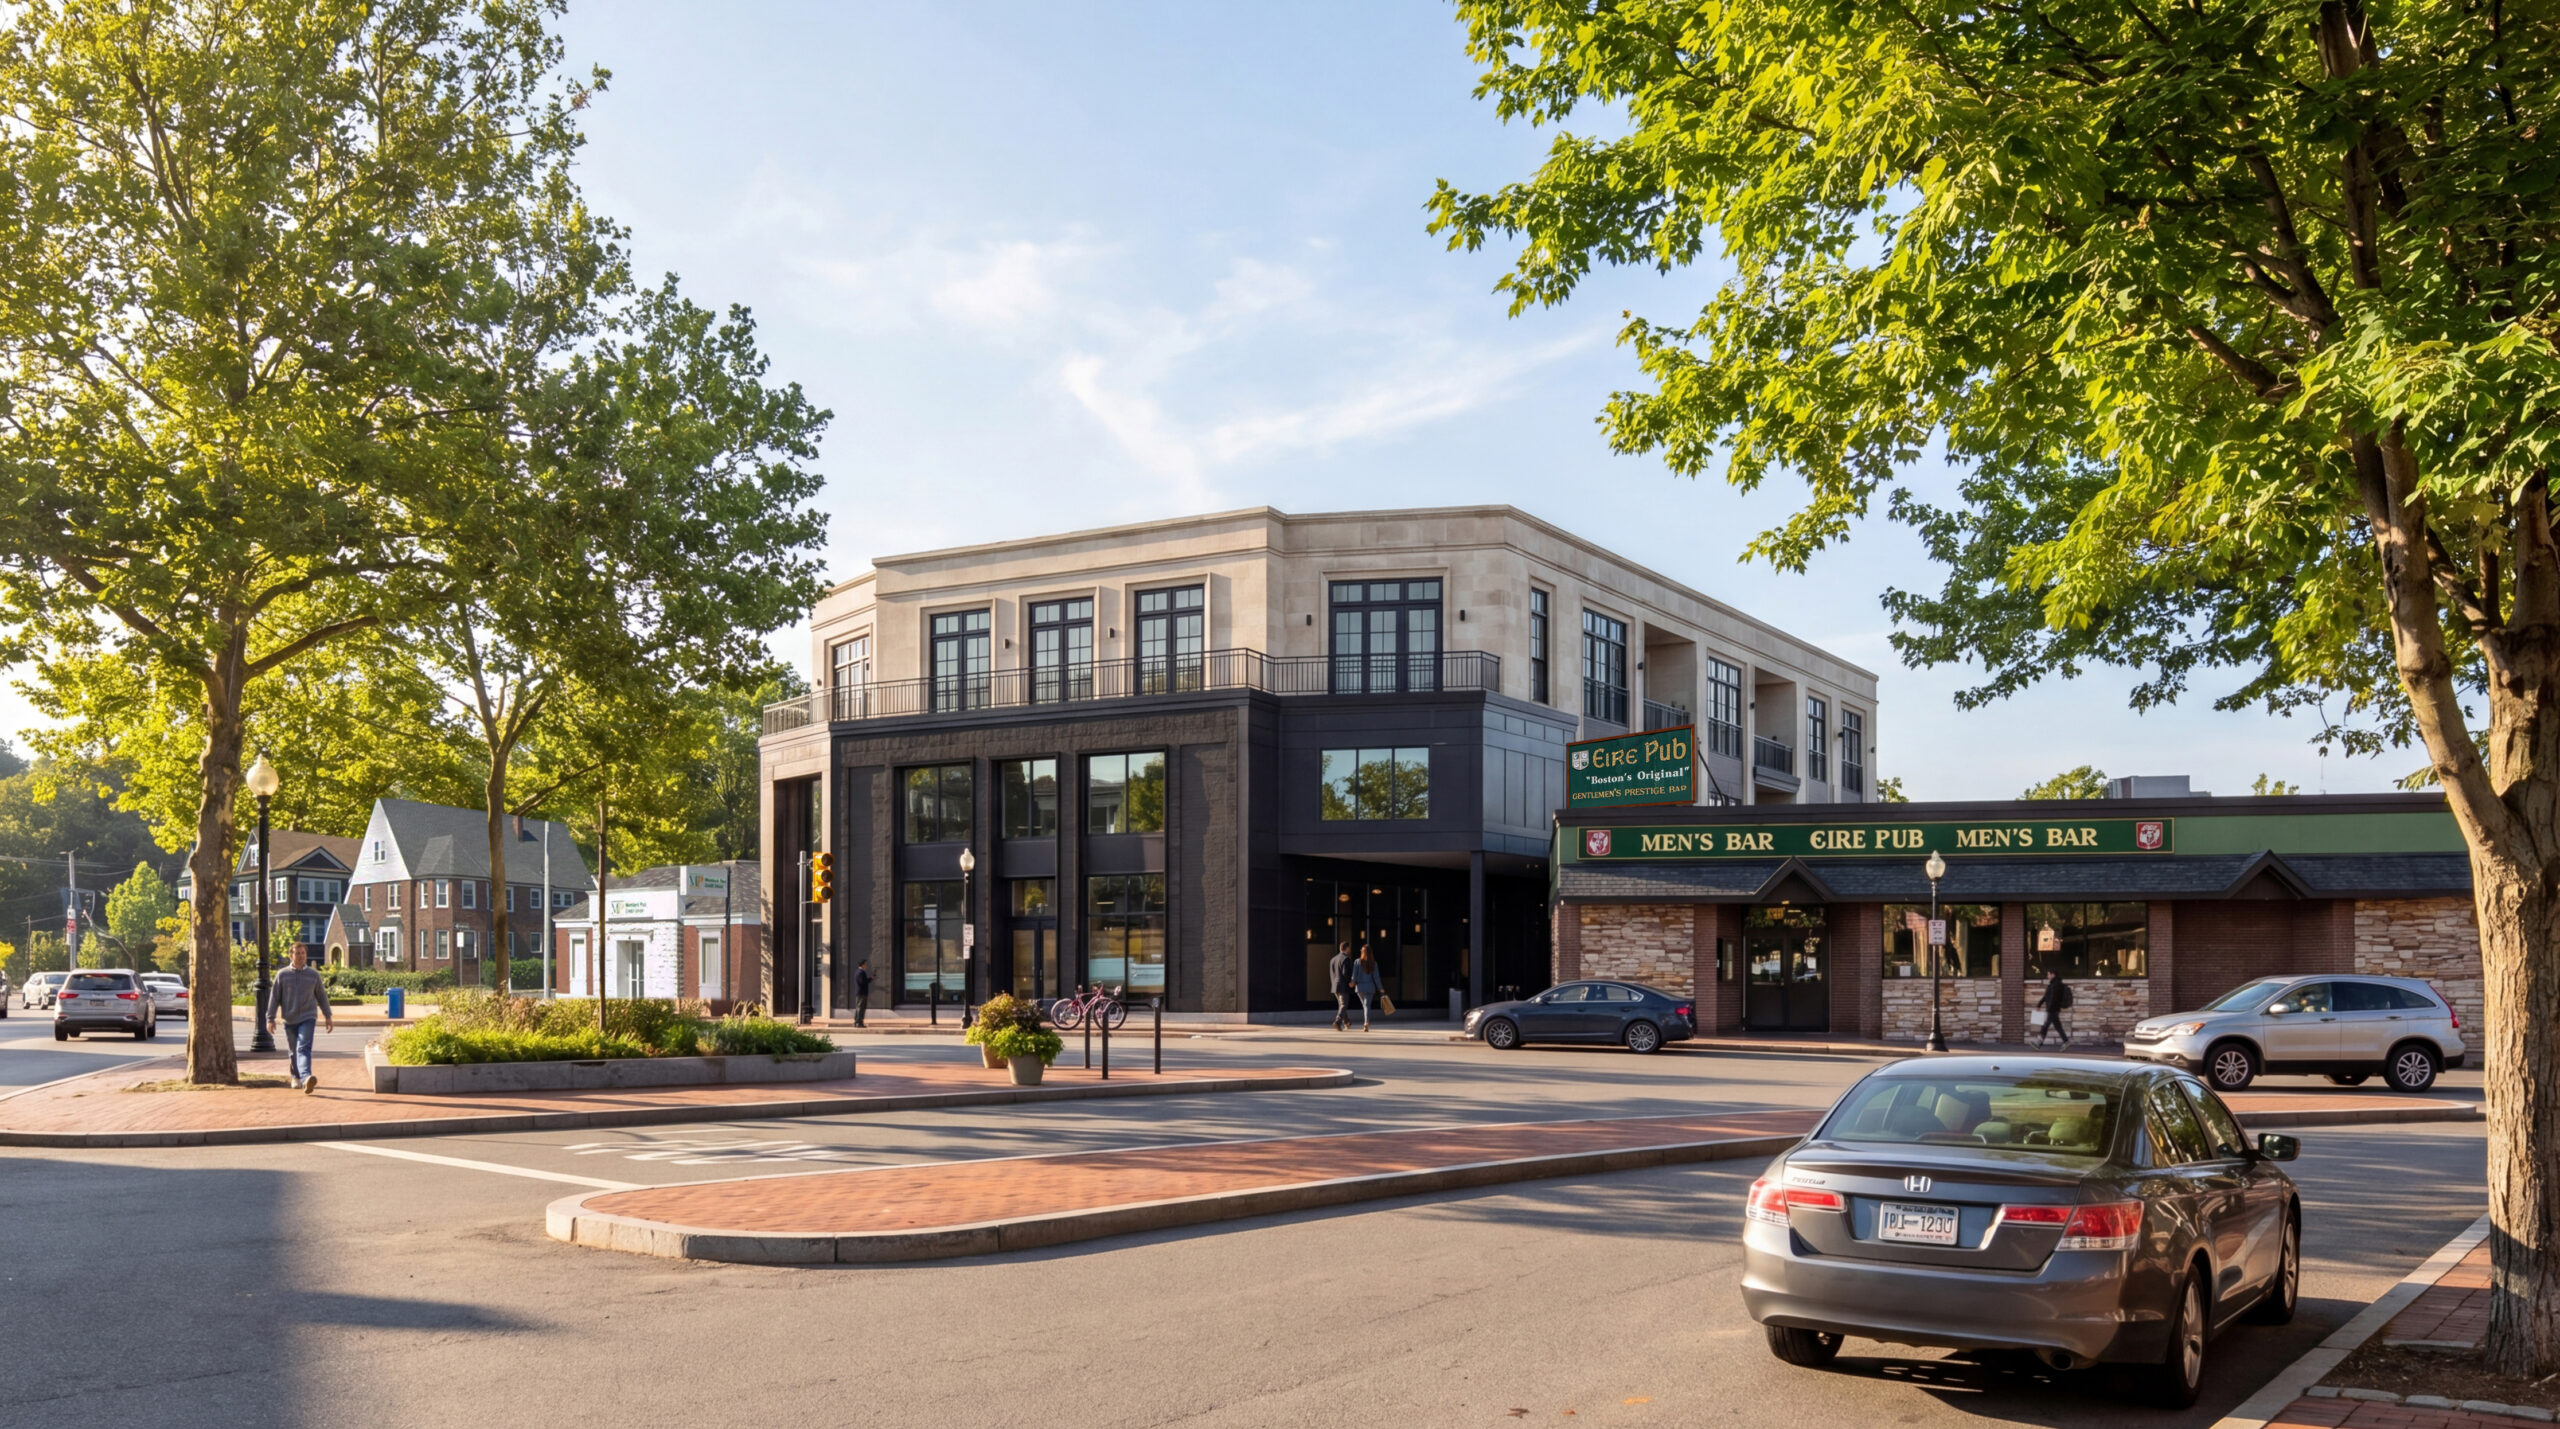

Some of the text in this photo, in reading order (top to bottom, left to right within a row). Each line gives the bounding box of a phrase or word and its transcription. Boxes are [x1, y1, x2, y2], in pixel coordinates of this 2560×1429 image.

[1645, 737, 1687, 763] Pub
[1586, 766, 1690, 785] "Boston's Original"
[1572, 784, 1688, 800] GENTLEMEN'S PRESTIGE BAR
[1640, 827, 2099, 852] MEN'S BAR EIRE PUB MEN'S BAR
